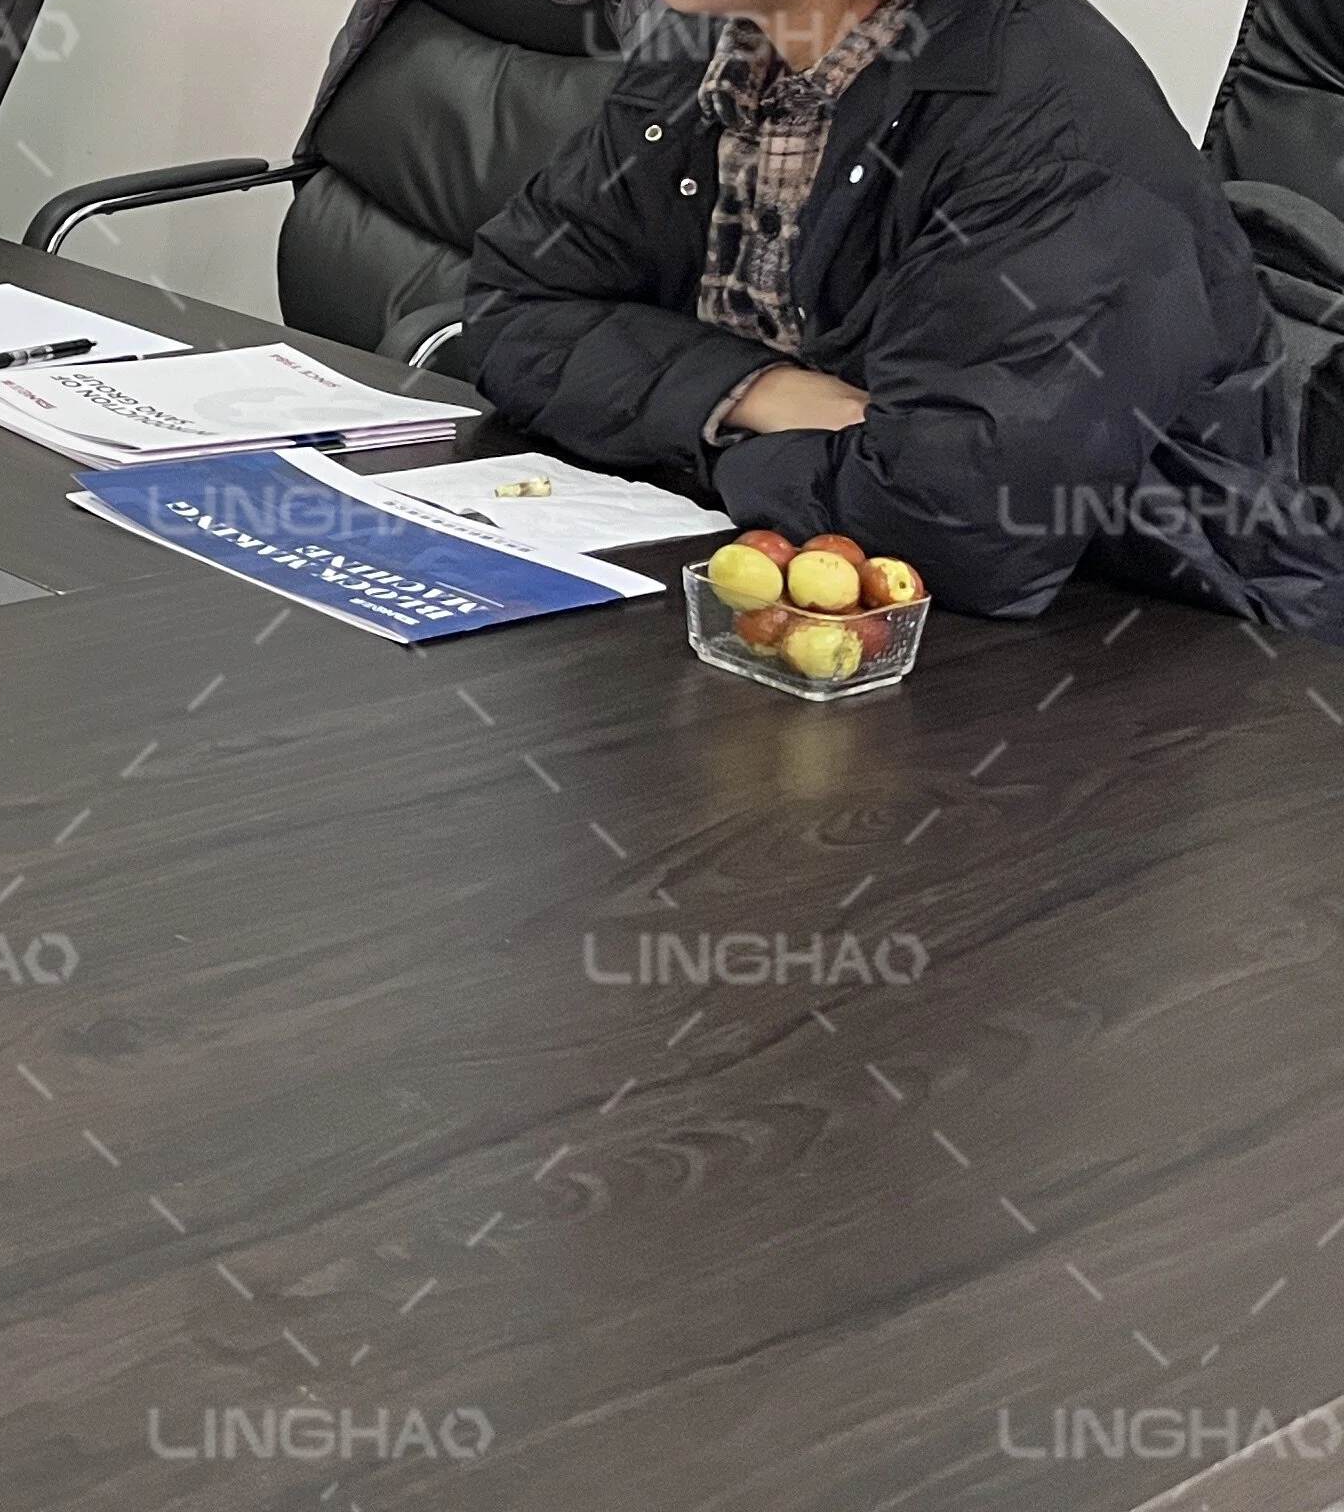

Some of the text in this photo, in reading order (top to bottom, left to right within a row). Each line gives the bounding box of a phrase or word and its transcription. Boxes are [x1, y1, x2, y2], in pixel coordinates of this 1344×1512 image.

[72, 373, 140, 405] GROUP
[165, 500, 312, 571] MAKING
[295, 544, 490, 615] MACHINE
[311, 567, 456, 621] BLOCK
